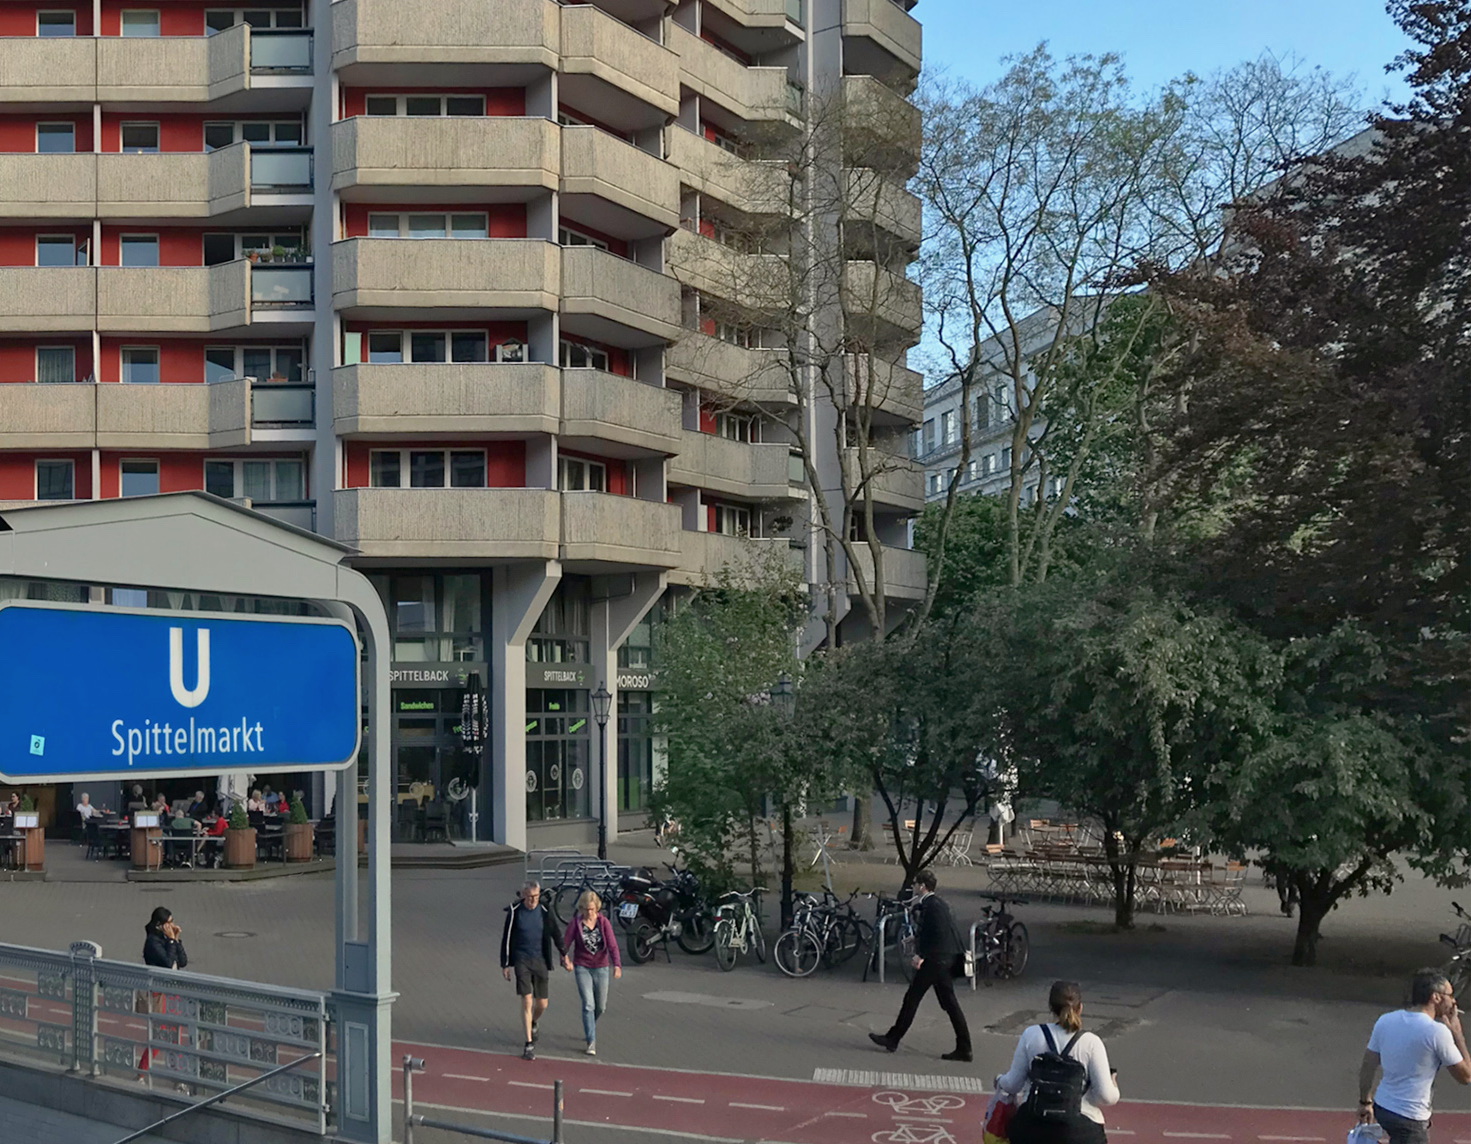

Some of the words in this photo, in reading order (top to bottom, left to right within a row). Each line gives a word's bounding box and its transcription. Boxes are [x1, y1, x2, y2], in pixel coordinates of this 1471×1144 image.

[169, 627, 210, 708] U
[544, 670, 577, 682] SPITTELBACK
[400, 701, 434, 710] Sandwiches
[111, 716, 264, 766] Spittelmarkt
